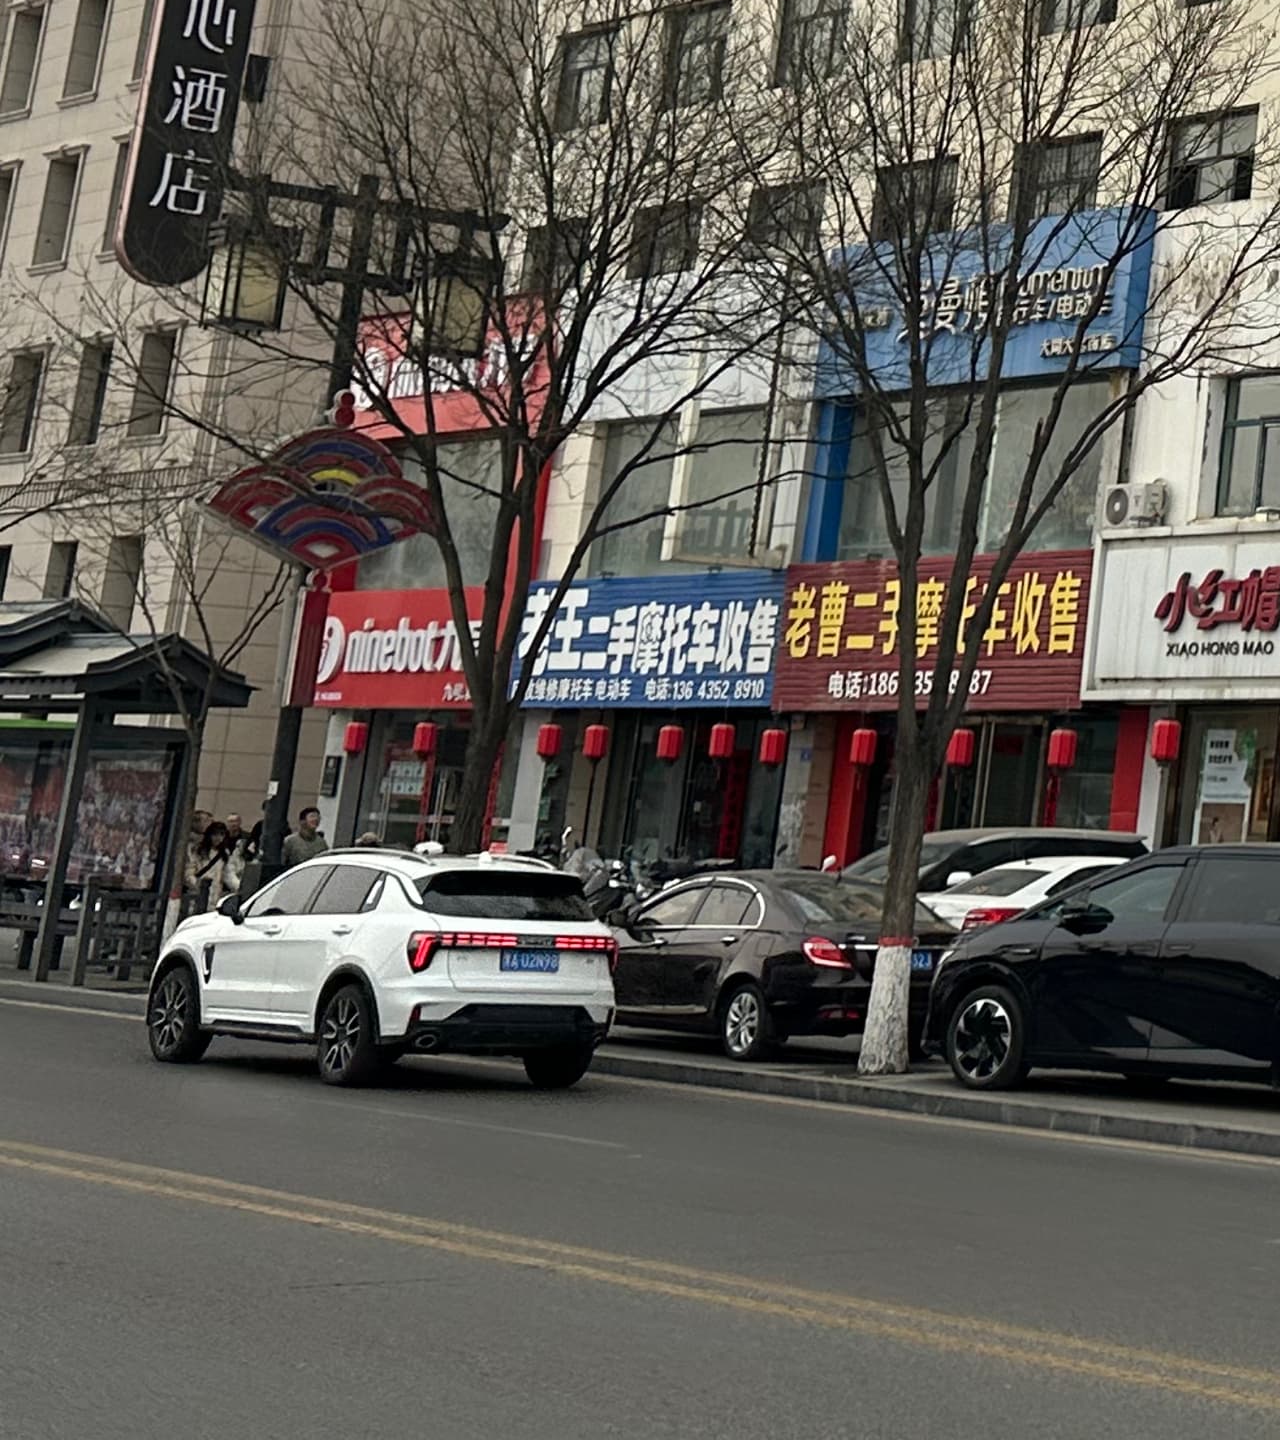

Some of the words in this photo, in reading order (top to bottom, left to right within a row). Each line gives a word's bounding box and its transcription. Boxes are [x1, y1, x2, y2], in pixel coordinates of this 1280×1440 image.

[343, 616, 438, 673] ninebot
[518, 586, 780, 676] 老王二手摩托车收售
[1166, 641, 1199, 658] XIAO
[1201, 641, 1240, 656] HONG
[1242, 640, 1275, 655] MAO
[697, 680, 730, 700] 4352
[734, 678, 765, 699] 8910
